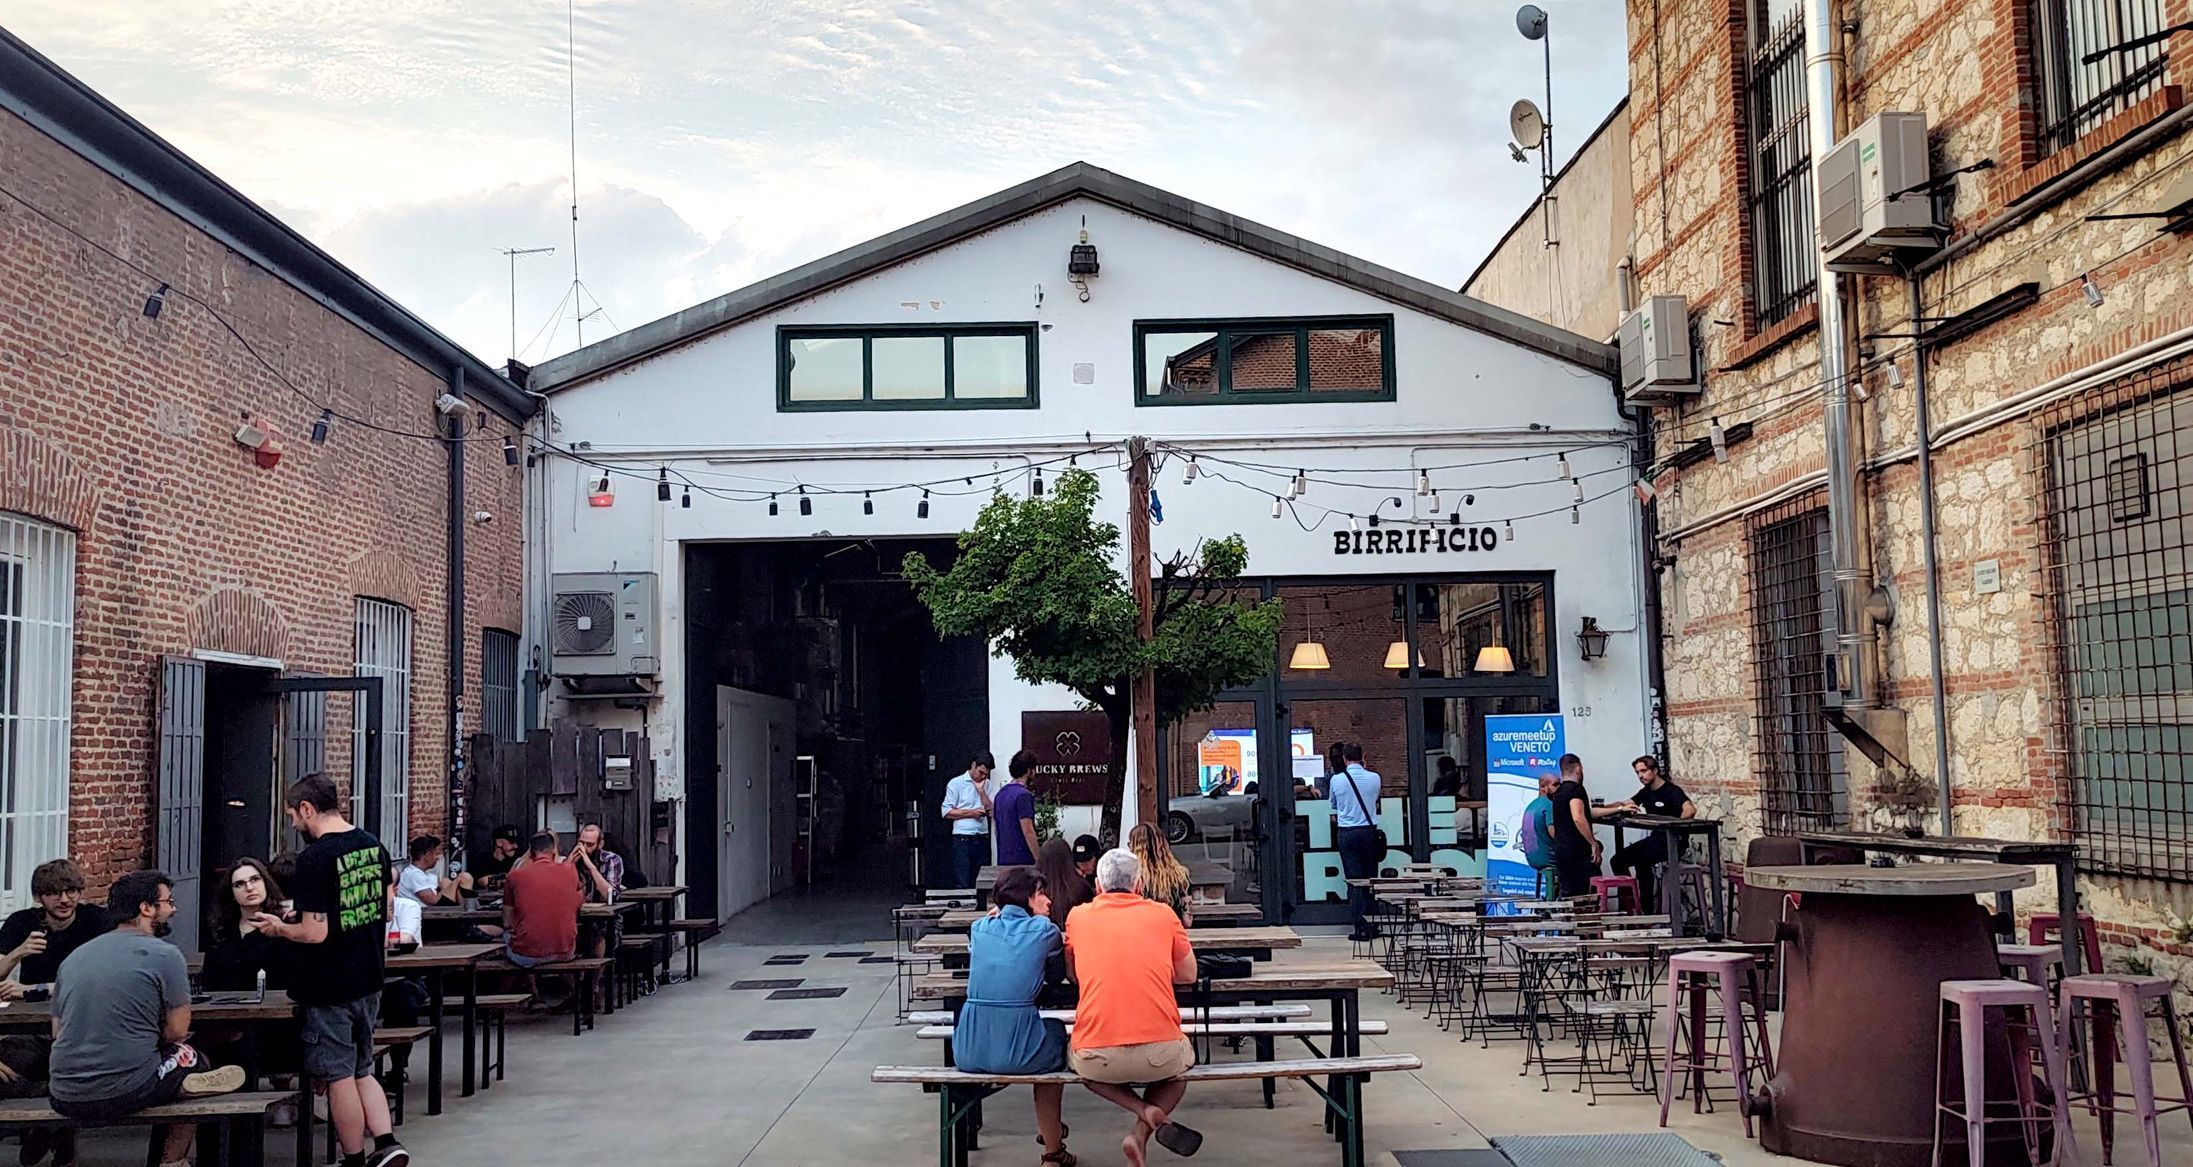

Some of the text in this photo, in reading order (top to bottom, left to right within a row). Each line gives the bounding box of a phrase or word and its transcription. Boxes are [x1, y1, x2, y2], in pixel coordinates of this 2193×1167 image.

[1333, 527, 1497, 555] BIRRIFICIO
[1492, 729, 1556, 743] azuremeetup
[1510, 741, 1550, 753] VENETO
[1500, 757, 1525, 767] Microsoft
[1034, 764, 1108, 774] UCKY BREWS
